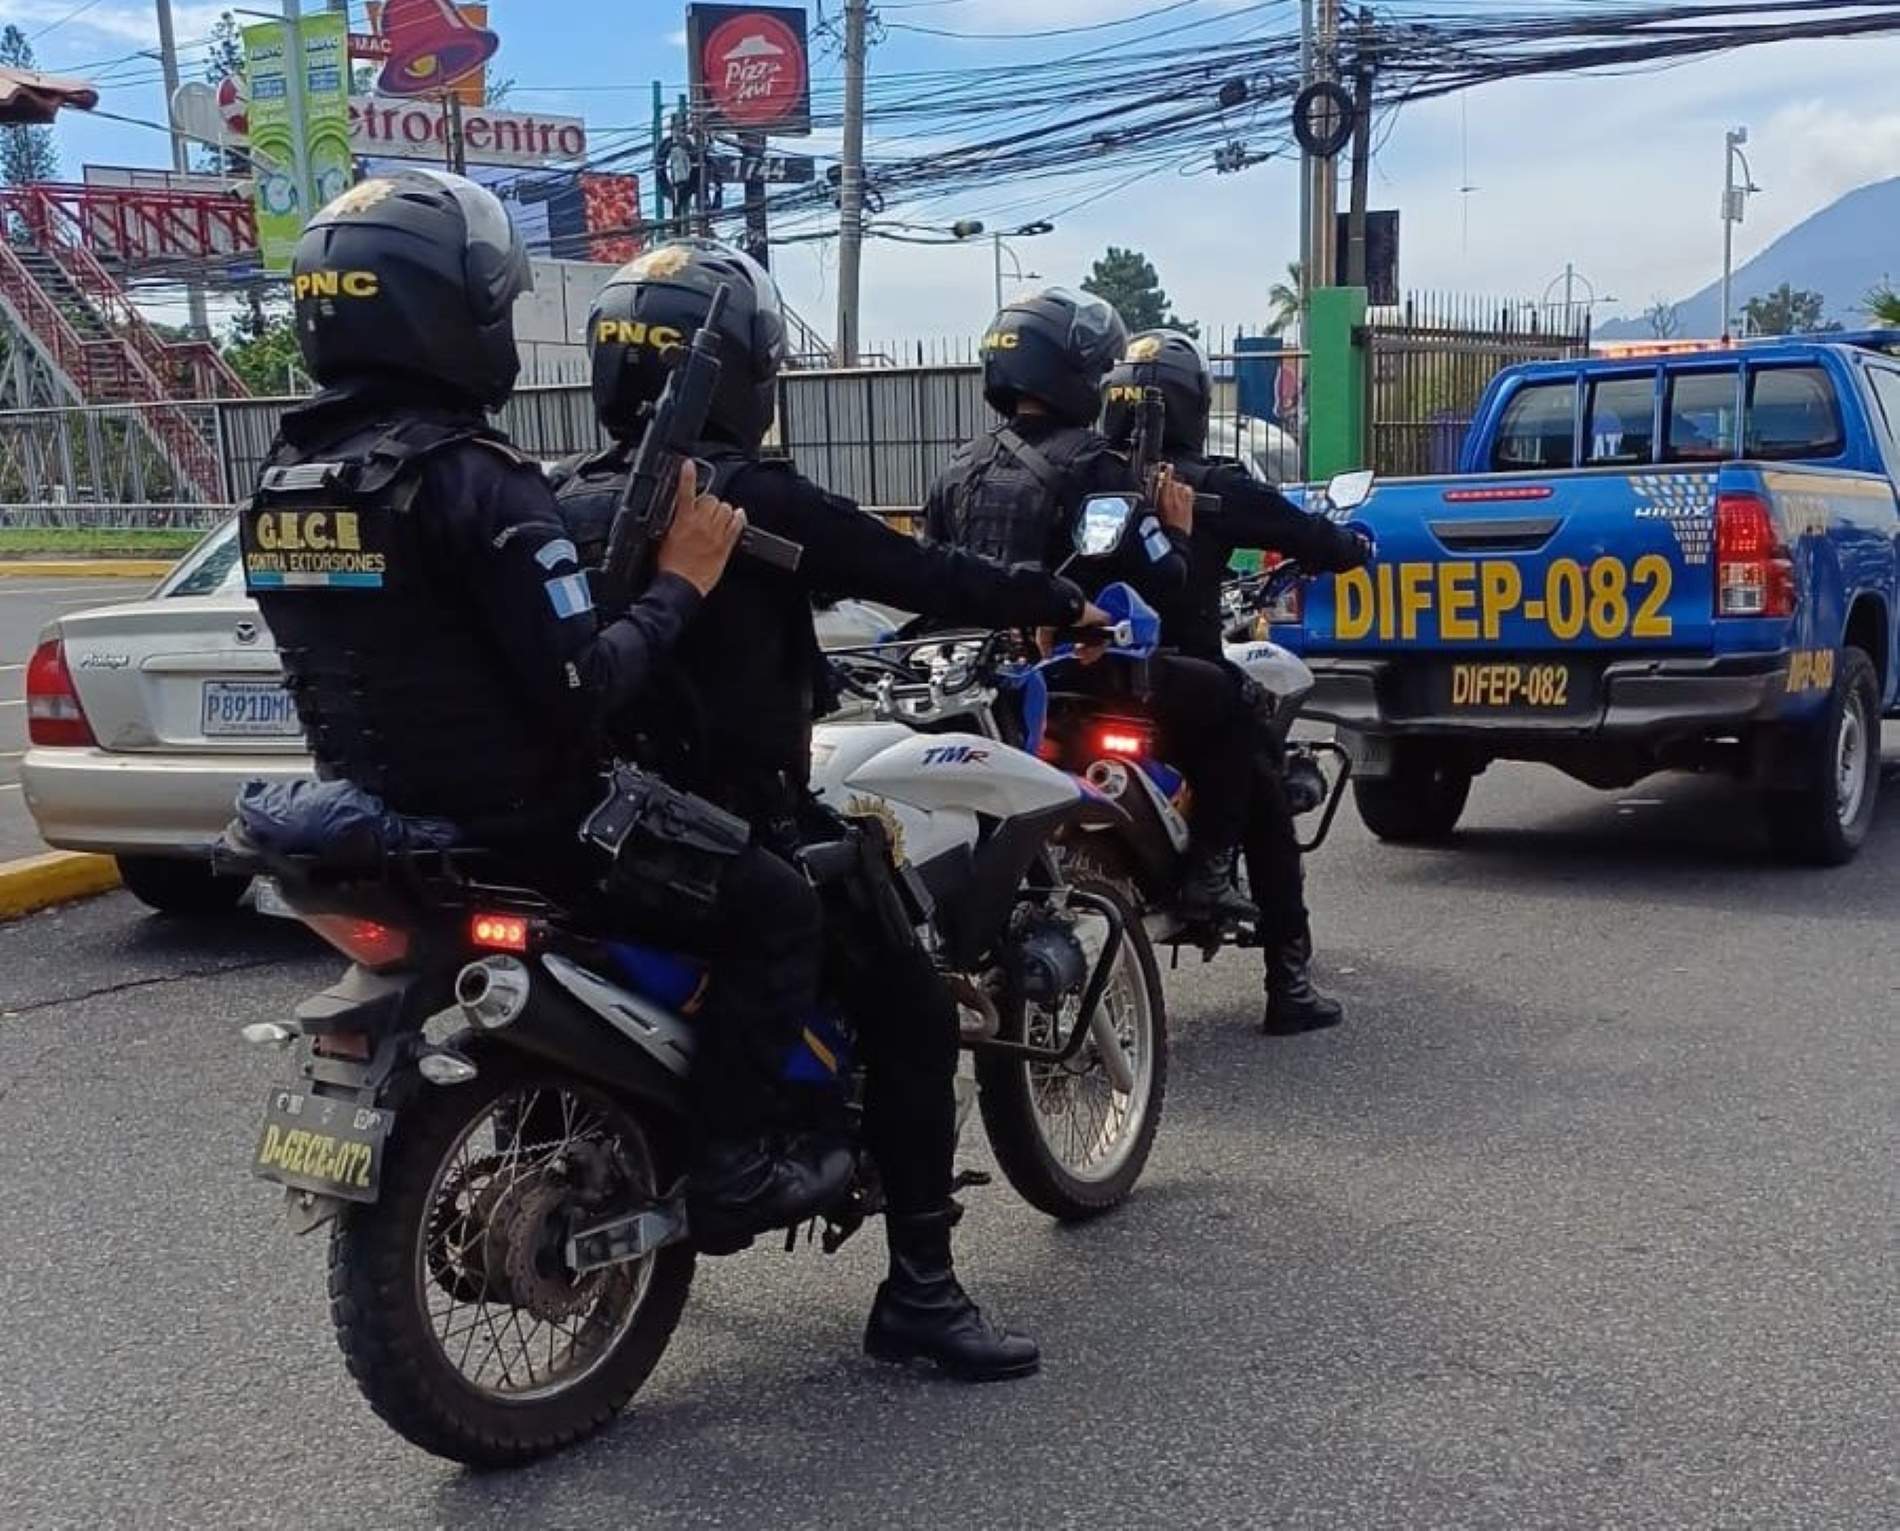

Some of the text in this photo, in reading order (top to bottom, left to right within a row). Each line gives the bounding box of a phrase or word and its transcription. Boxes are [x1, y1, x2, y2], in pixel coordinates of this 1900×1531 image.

[296, 271, 378, 301] PNC
[598, 321, 683, 348] PNC
[290, 553, 386, 572] EXTORSIONES
[1334, 554, 1673, 641] DIFEP-082
[1453, 665, 1568, 705] DIFEP-082
[922, 746, 989, 765] TMR
[259, 1124, 372, 1187] D-GECE-072
